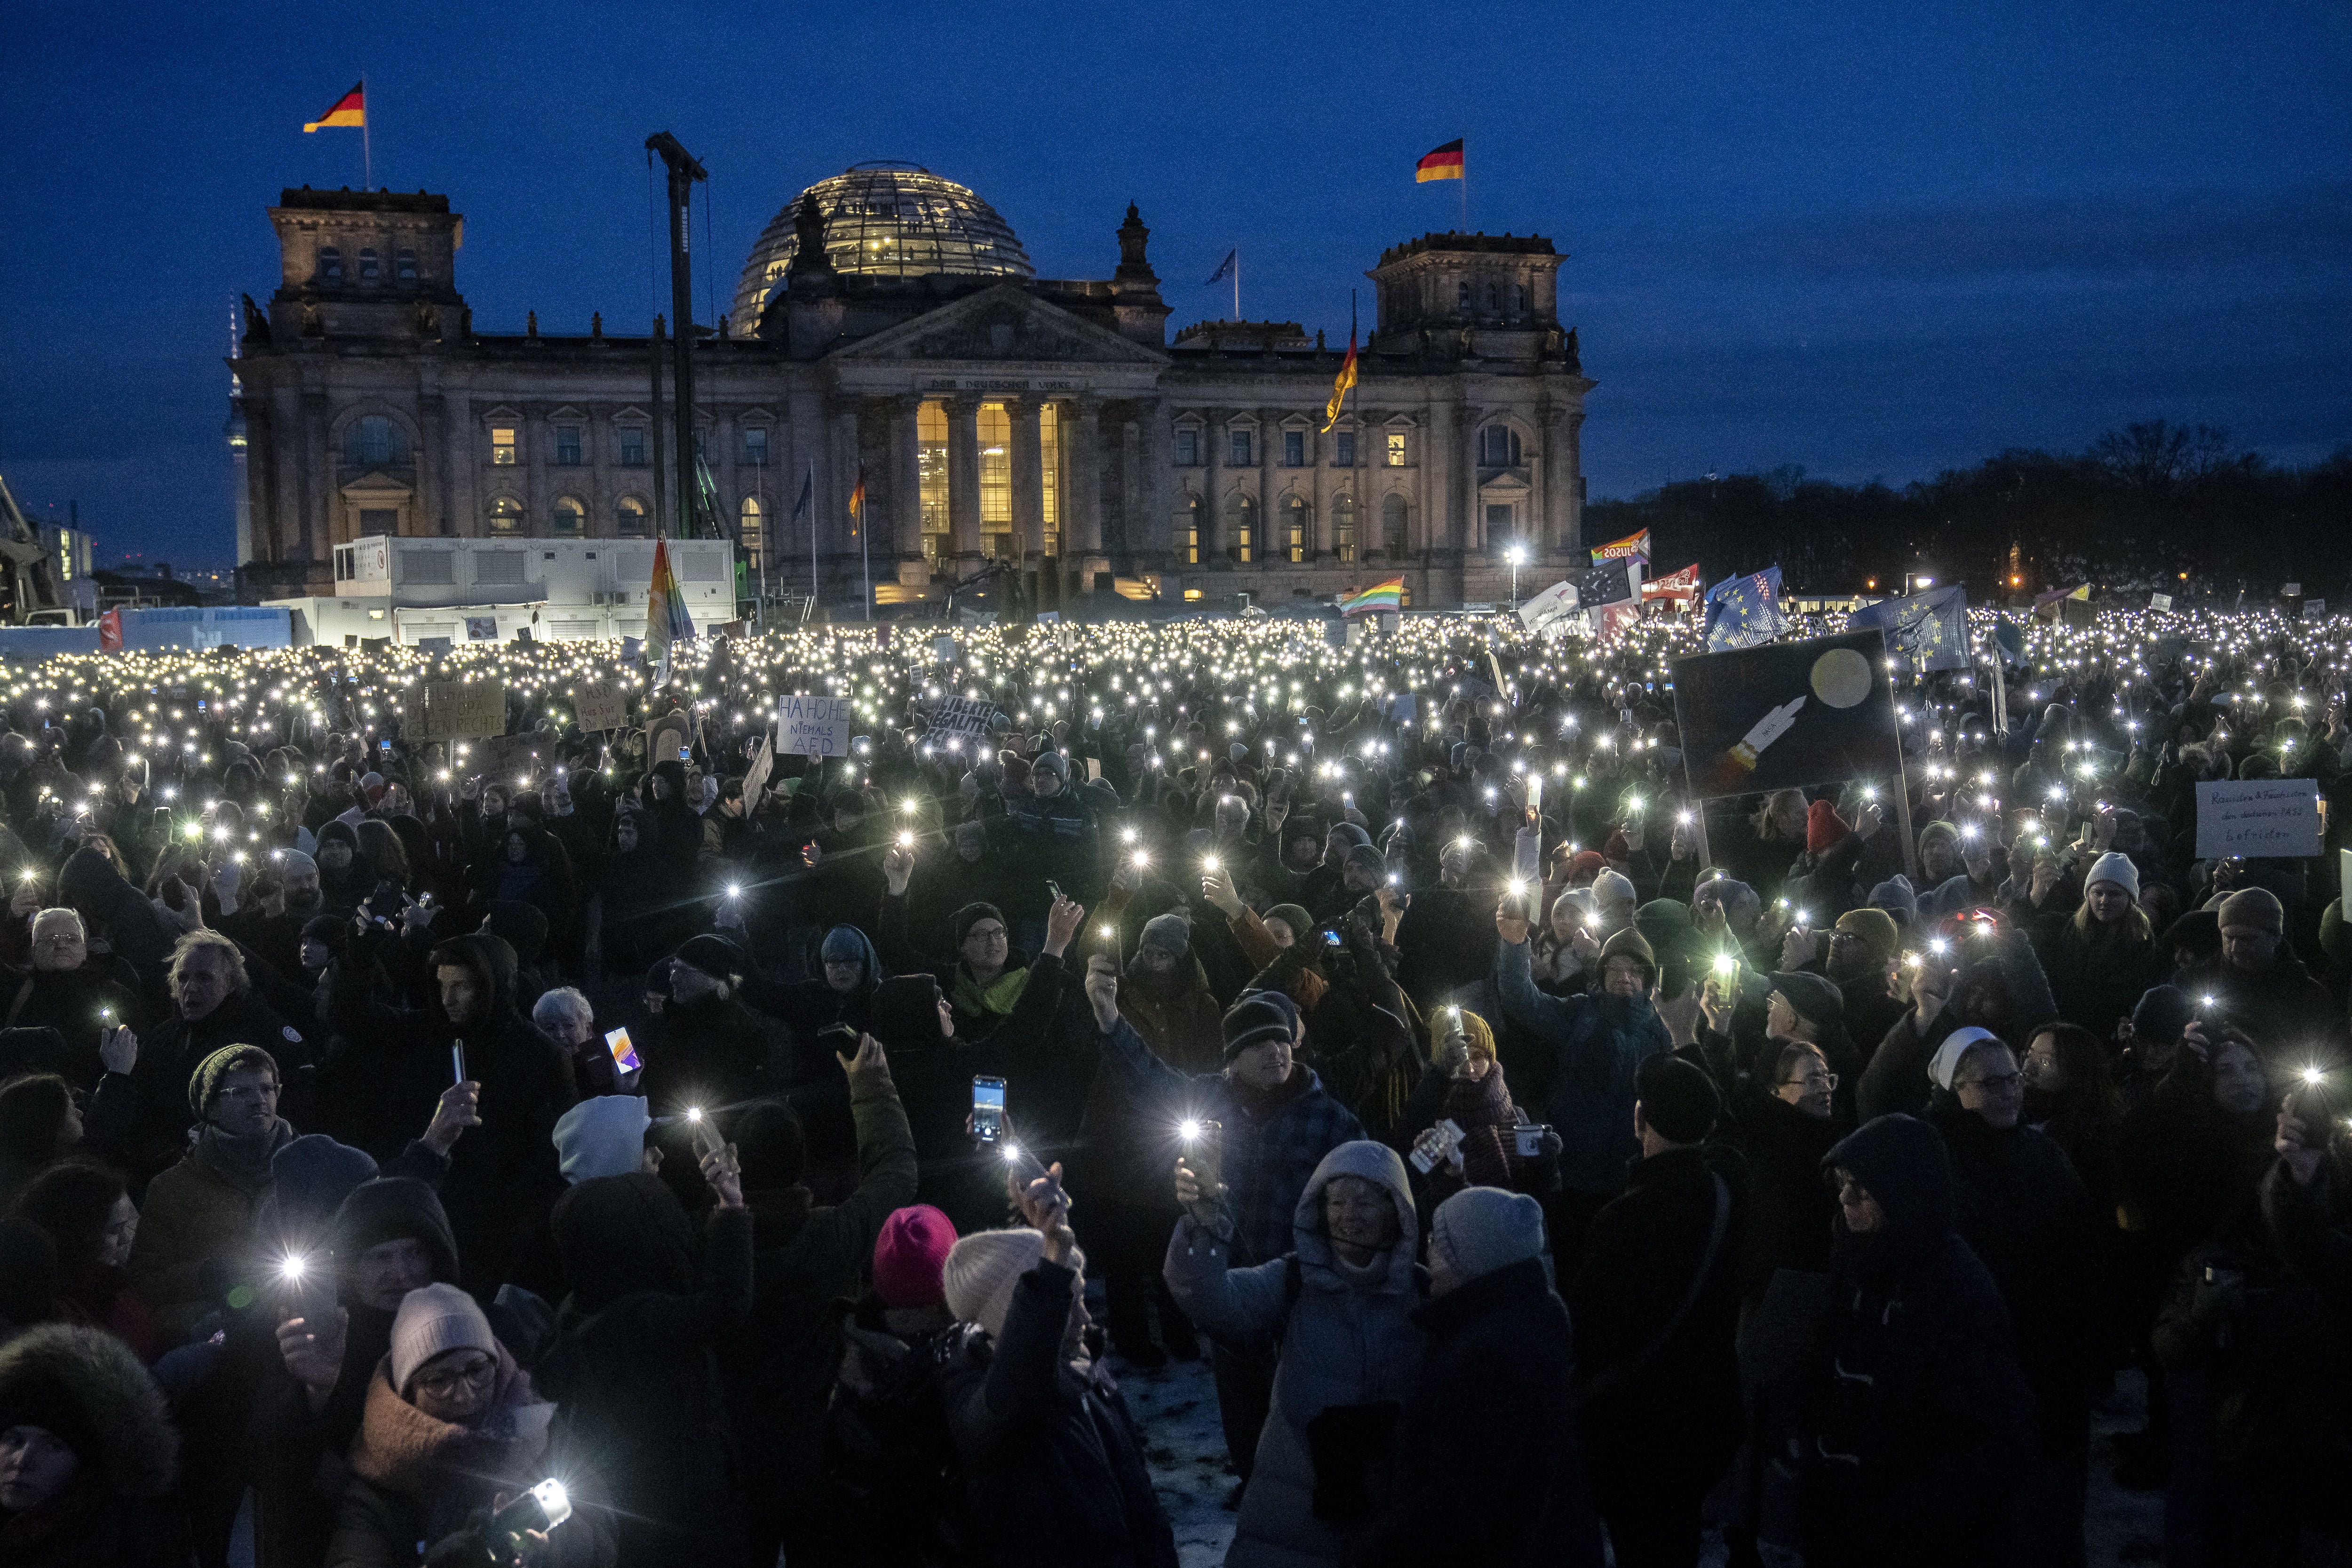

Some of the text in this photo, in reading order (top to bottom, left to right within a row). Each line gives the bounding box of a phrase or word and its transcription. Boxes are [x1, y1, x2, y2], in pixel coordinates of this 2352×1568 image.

[966, 380, 1029, 389] DEUTSCHEN
[1808, 616, 1827, 628] FCK
[458, 700, 484, 716] OPA
[780, 697, 850, 721] HA HO HE
[457, 715, 502, 732] RECHTS
[1762, 724, 1777, 737] NASA
[792, 737, 833, 754] AFD
[2281, 807, 2303, 817] PASS
[2226, 828, 2290, 842] befristen
